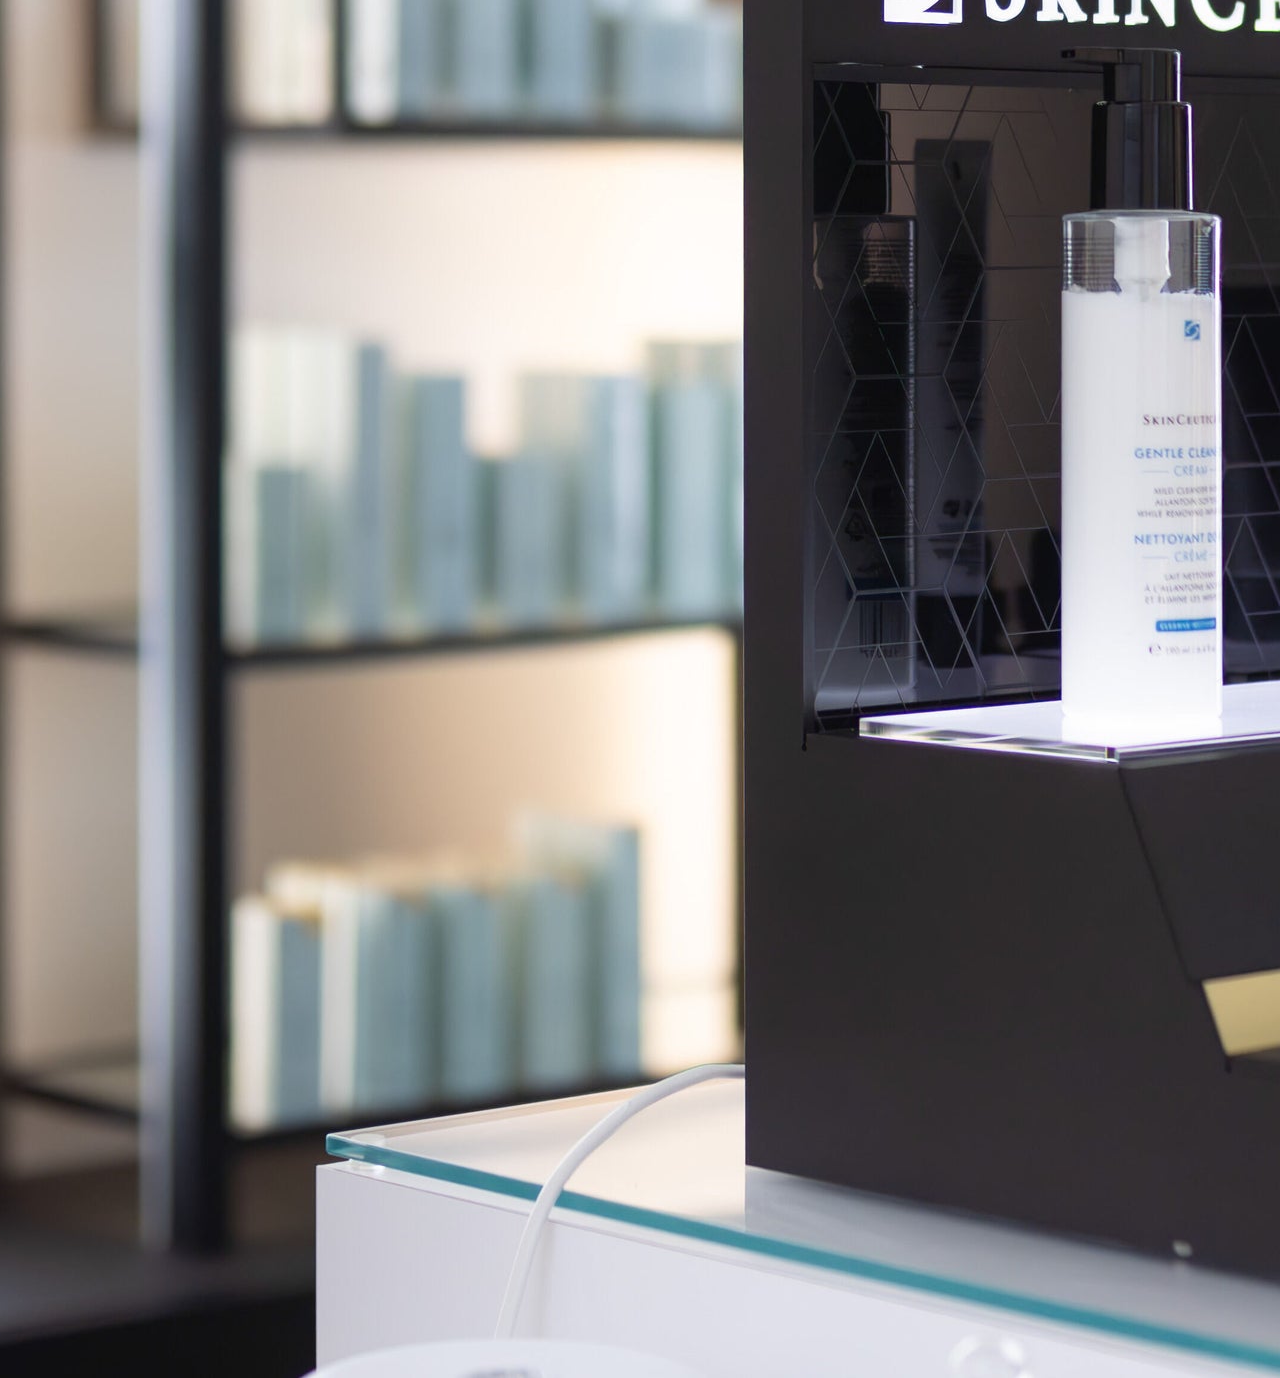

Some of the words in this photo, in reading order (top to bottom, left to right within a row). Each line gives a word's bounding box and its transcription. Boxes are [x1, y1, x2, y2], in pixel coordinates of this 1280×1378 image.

[1134, 447, 1184, 459] GENTLE
[1188, 447, 1217, 459] CLEAN
[1174, 465, 1208, 477] CREAM
[1134, 532, 1205, 545] NETTOYANT
